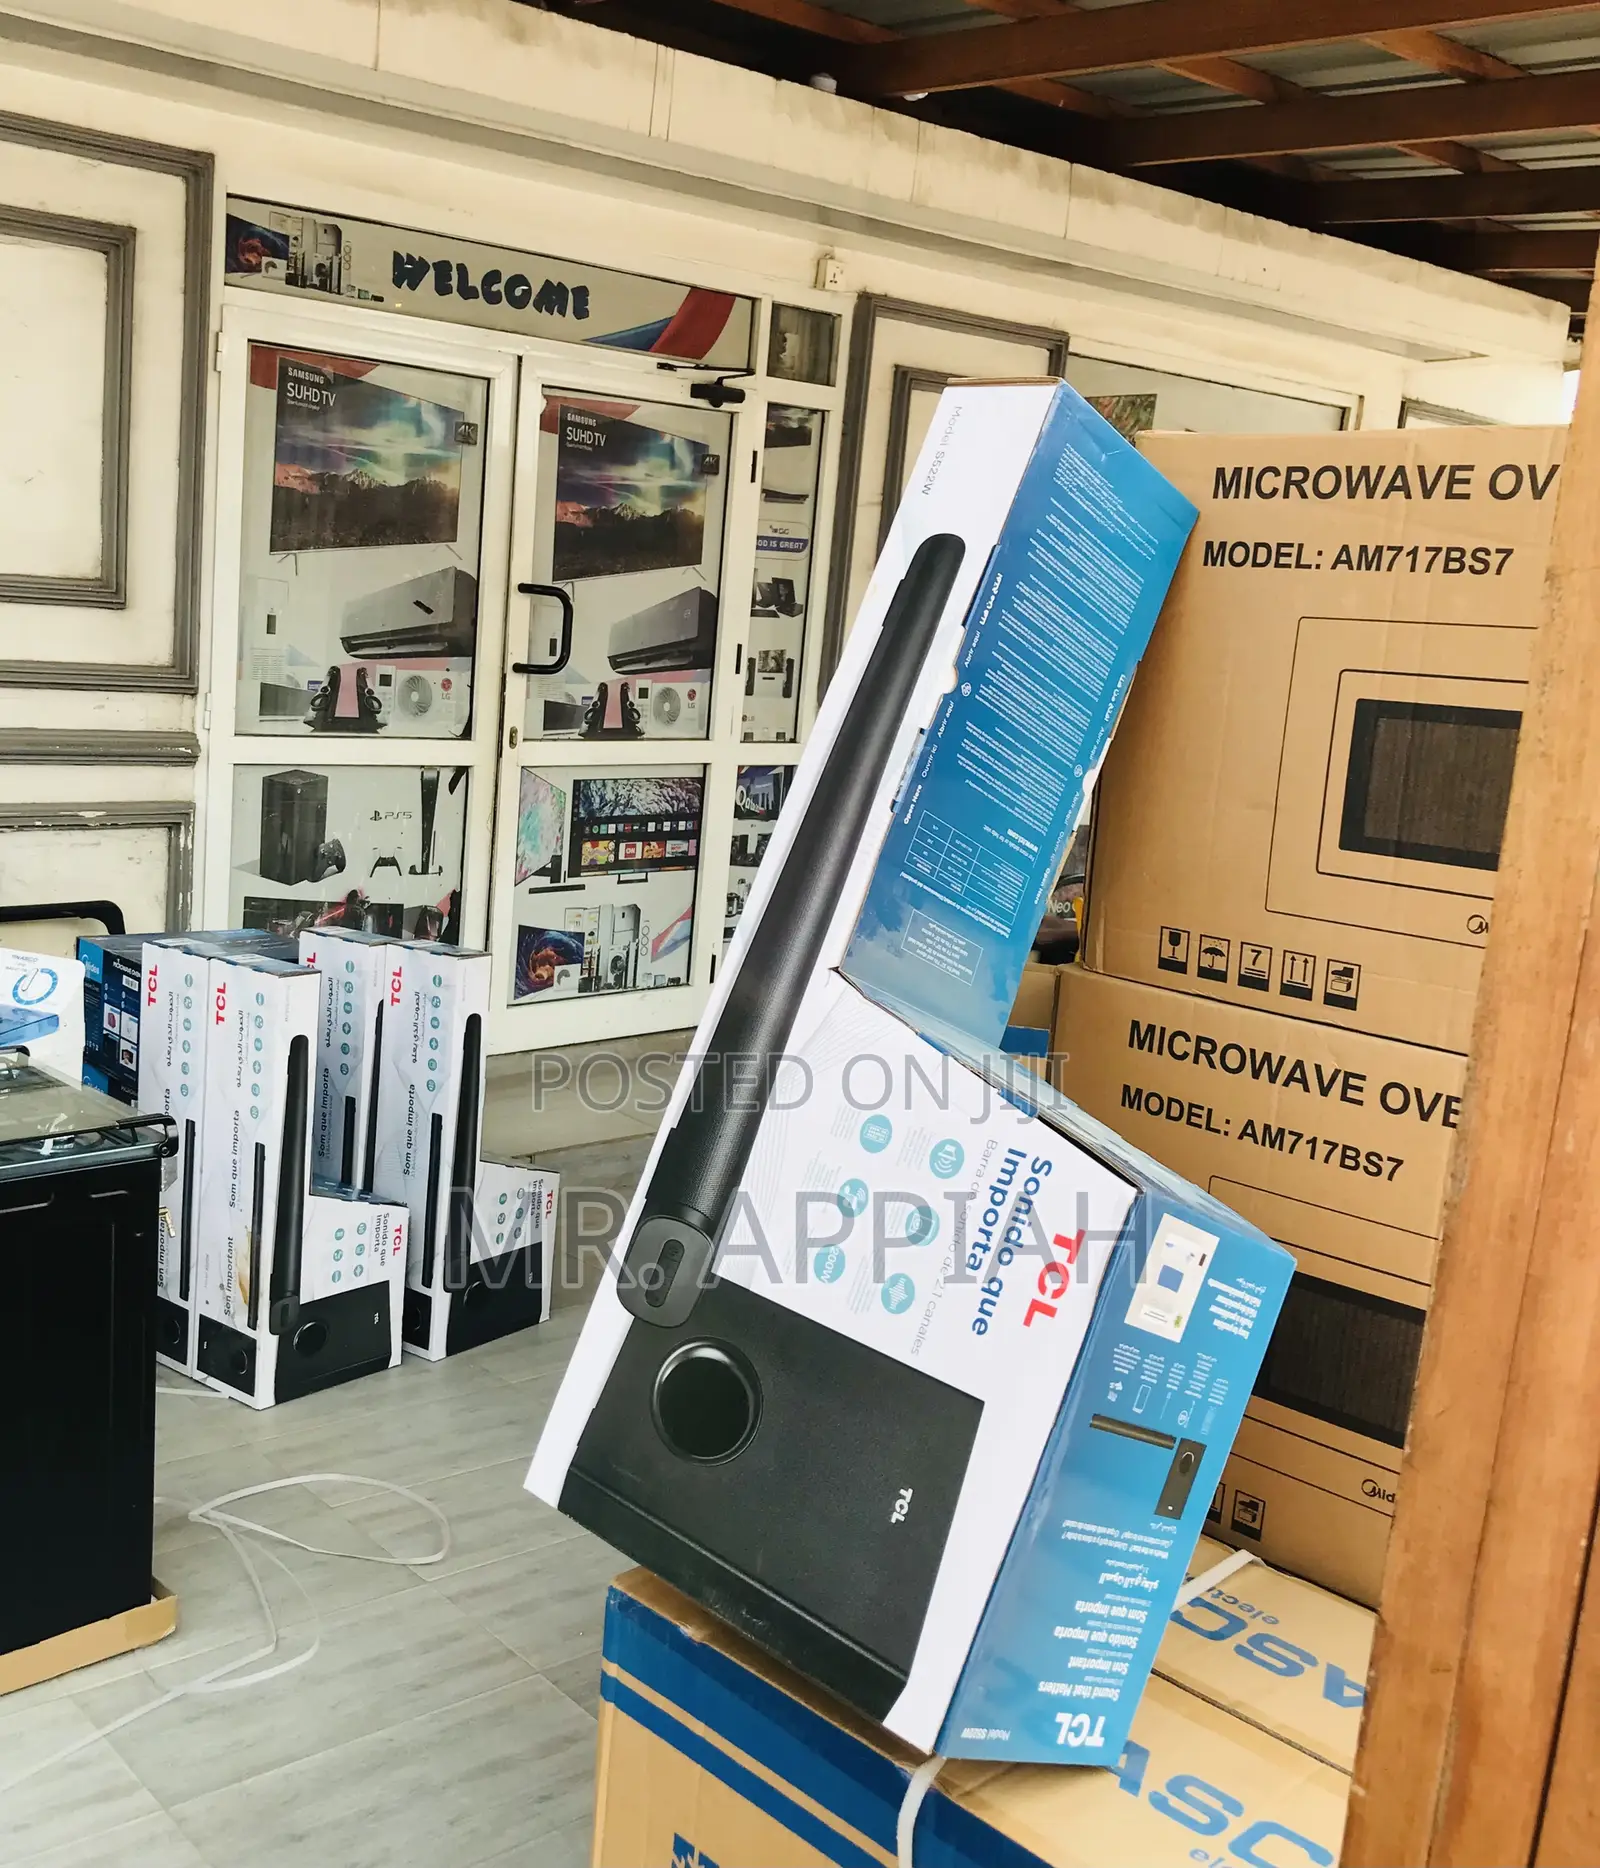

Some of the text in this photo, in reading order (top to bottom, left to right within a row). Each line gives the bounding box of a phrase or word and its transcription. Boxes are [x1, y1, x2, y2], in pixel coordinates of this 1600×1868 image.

[392, 251, 591, 319] WELCOME
[287, 367, 325, 385] SAMSUNG
[287, 382, 320, 403] SUHD
[321, 392, 336, 407] TV
[567, 413, 596, 426] SAMSUNG
[566, 427, 607, 447] SUHD TV
[922, 406, 962, 495] Model S522W
[1212, 464, 1473, 501] MICROWAVE
[780, 541, 804, 549] GREAT
[1202, 540, 1514, 576] MODEL: AM717BS7
[963, 648, 975, 669] Abrir
[441, 692, 451, 700] LG
[936, 717, 948, 738] Abrir
[1095, 726, 1105, 745] Abrir
[921, 755, 934, 778] Ouvrir
[903, 784, 923, 825] Open Here
[1069, 790, 1080, 810] Abrir
[385, 811, 412, 820] PS5
[1033, 867, 1051, 905] Open Here
[148, 964, 159, 1006] TCL
[391, 966, 402, 1006] TCL
[216, 982, 226, 1025] TCL
[1128, 1019, 1367, 1106] MICROWAVE
[1120, 1084, 1405, 1182] MODEL: AM717BS7
[230, 1158, 238, 1182] que
[975, 1139, 998, 1178] Barra
[967, 1181, 979, 1200] de
[545, 1191, 553, 1220] TCL
[965, 1148, 1027, 1271] Importa
[392, 1224, 402, 1256] TCL
[948, 1204, 972, 1253] sonido
[971, 1156, 1052, 1336] Sonido que
[226, 1236, 234, 1290] important
[940, 1256, 953, 1274] de
[1023, 1229, 1086, 1327] TCL
[911, 1300, 936, 1356] canales
[891, 1488, 914, 1524] TCL
[1074, 1600, 1110, 1617] importa
[1110, 1604, 1127, 1618] que
[1128, 1608, 1148, 1623] Som
[1090, 1628, 1107, 1644] que
[1108, 1632, 1139, 1649] Sonido
[1067, 1655, 1129, 1675] Son important
[1038, 1681, 1073, 1697] Matters
[1073, 1684, 1092, 1699] that
[1091, 1686, 1120, 1702] Sound
[987, 1728, 1011, 1741] Model
[1054, 1711, 1106, 1748] TCL
